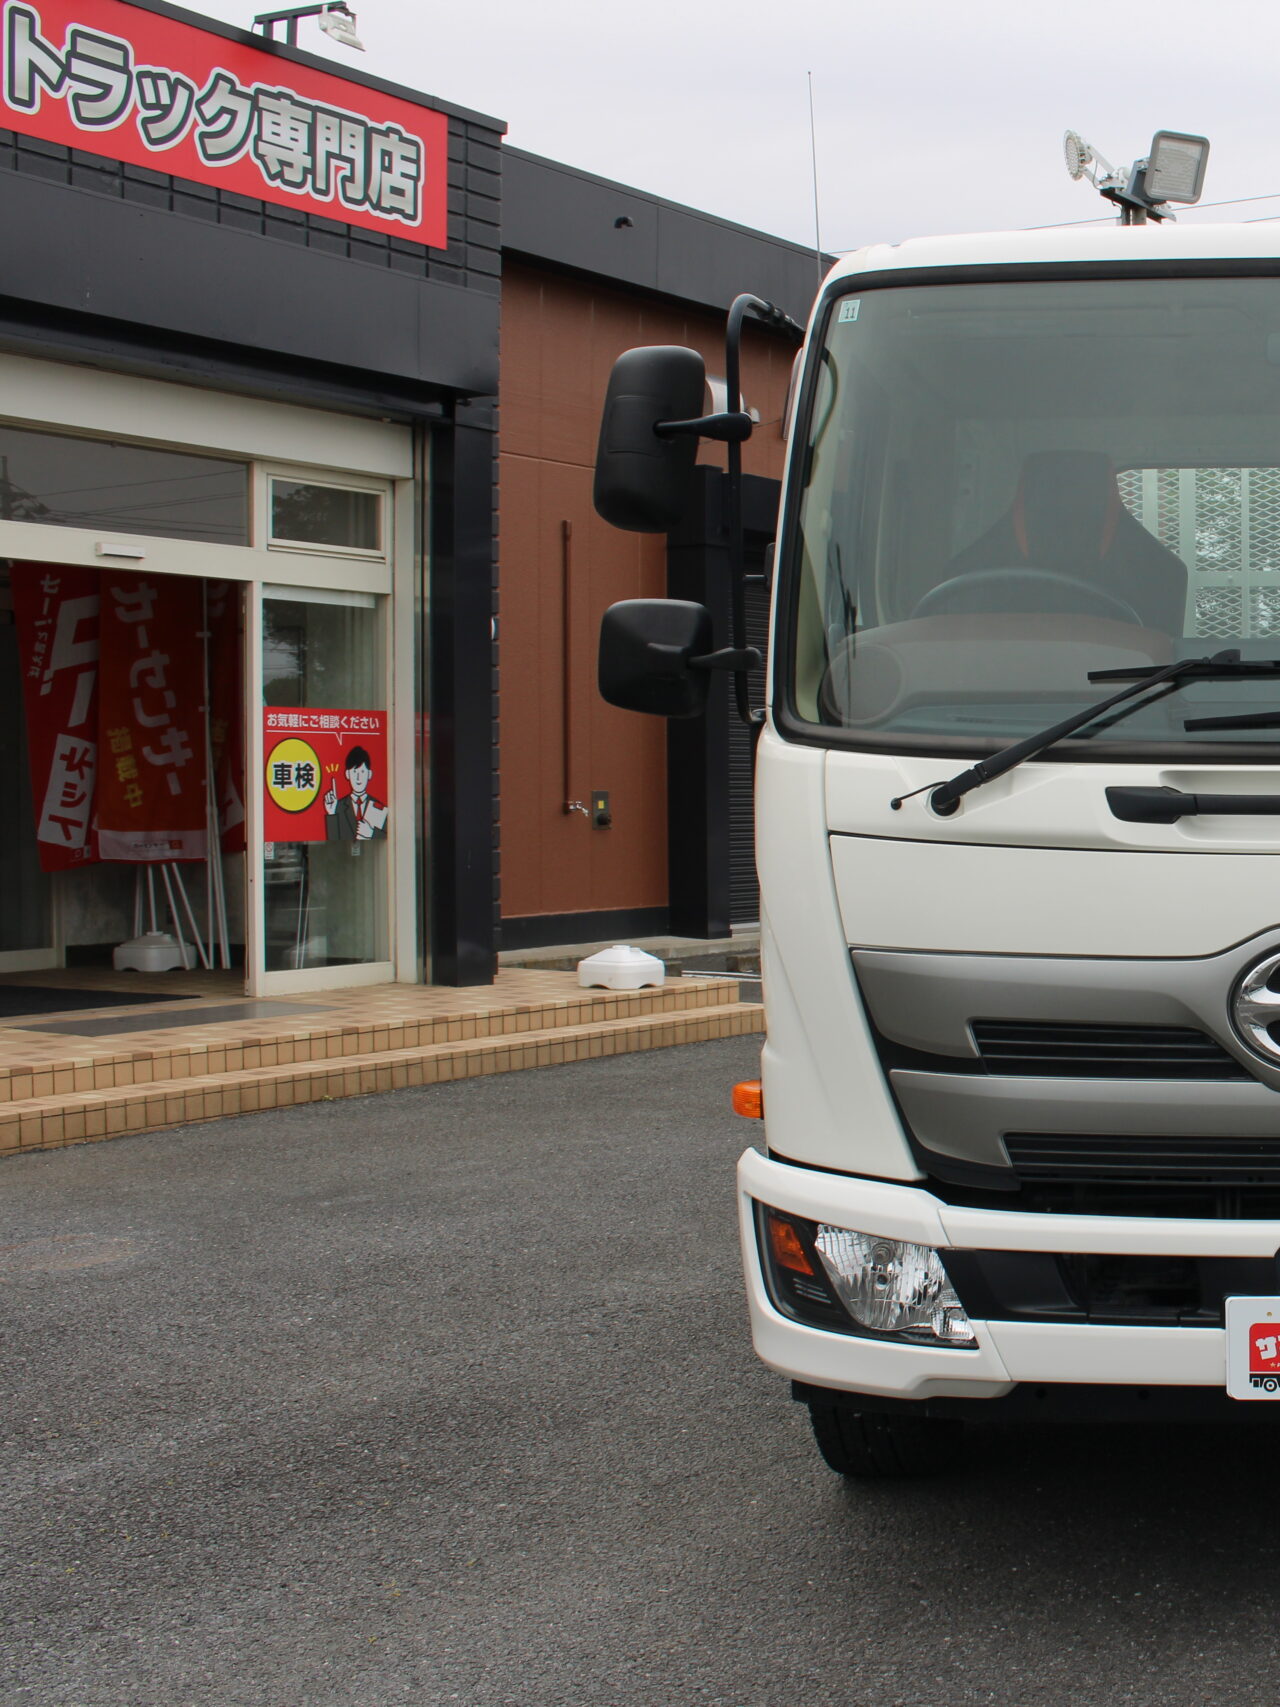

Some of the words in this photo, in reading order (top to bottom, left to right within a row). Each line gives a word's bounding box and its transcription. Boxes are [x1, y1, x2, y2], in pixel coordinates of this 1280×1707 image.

[3, 5, 425, 226] トラック専門店
[266, 713, 380, 730] お気軽にご相談ください
[272, 761, 316, 790] 車検
